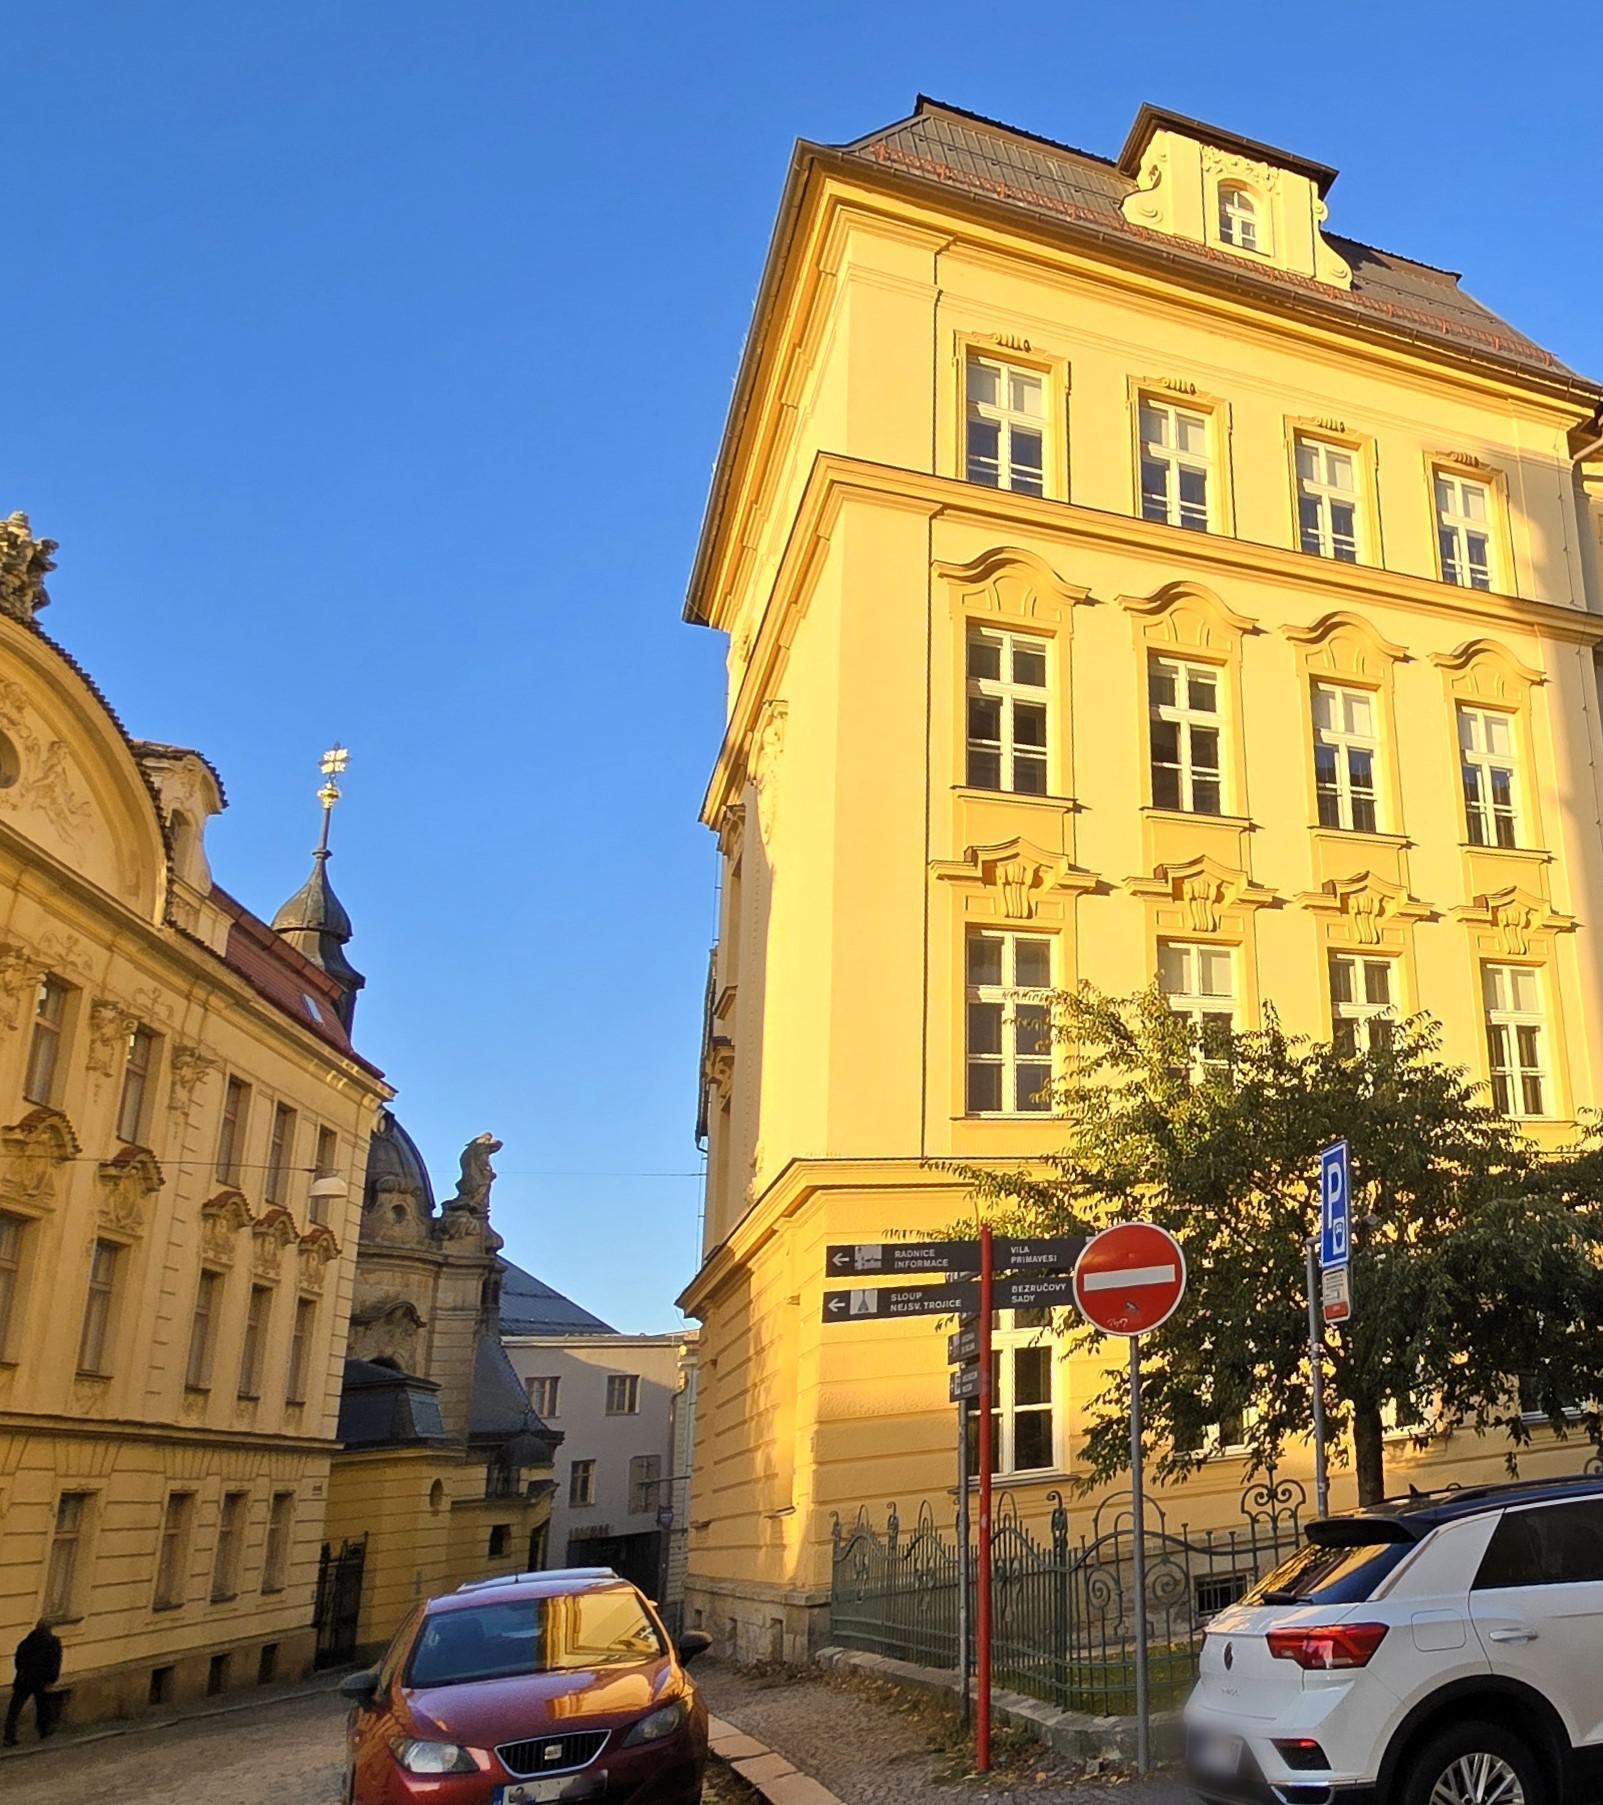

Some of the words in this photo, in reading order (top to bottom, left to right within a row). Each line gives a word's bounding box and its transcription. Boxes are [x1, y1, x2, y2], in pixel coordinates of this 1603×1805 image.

[1327, 1162, 1342, 1229] P
[894, 1249, 936, 1258] RADNICE
[1010, 1246, 1030, 1254] VILA
[894, 1259, 949, 1269] INFORMACE
[1010, 1255, 1057, 1264] PRIMAVESI
[1011, 1283, 1066, 1293] BEZRUČOVY
[890, 1292, 922, 1302] SLOUP
[1011, 1295, 1035, 1304] SADY
[923, 1300, 962, 1310] TROJICE
